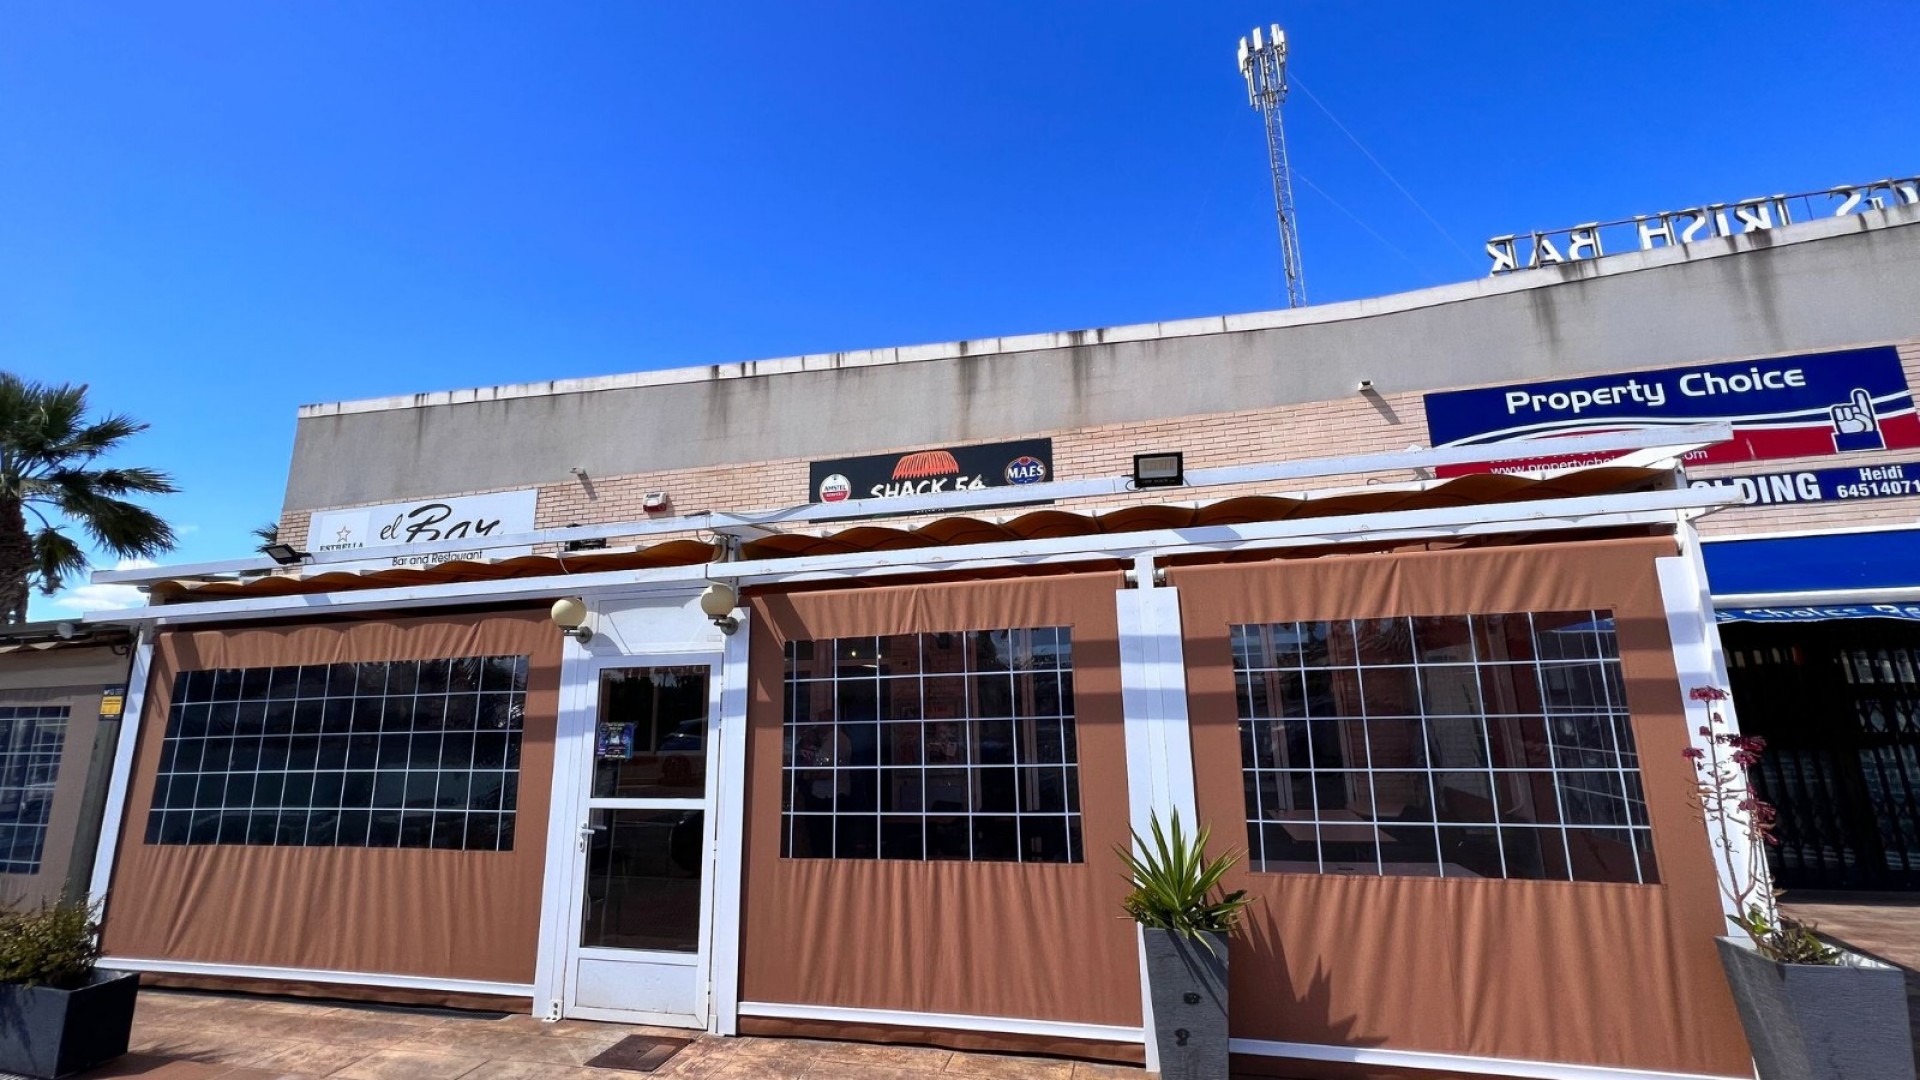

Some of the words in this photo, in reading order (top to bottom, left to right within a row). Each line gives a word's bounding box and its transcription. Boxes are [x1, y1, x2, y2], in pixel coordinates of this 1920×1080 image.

[1505, 379, 1666, 414] Property
[1679, 367, 1807, 396] Choice
[1007, 465, 1044, 478] MAES
[1859, 466, 1903, 481] Heidi
[870, 478, 948, 498] SHACK
[379, 514, 404, 541] el
[391, 557, 407, 567] Bar
[409, 555, 428, 565] and
[431, 550, 482, 564] Restaurant
